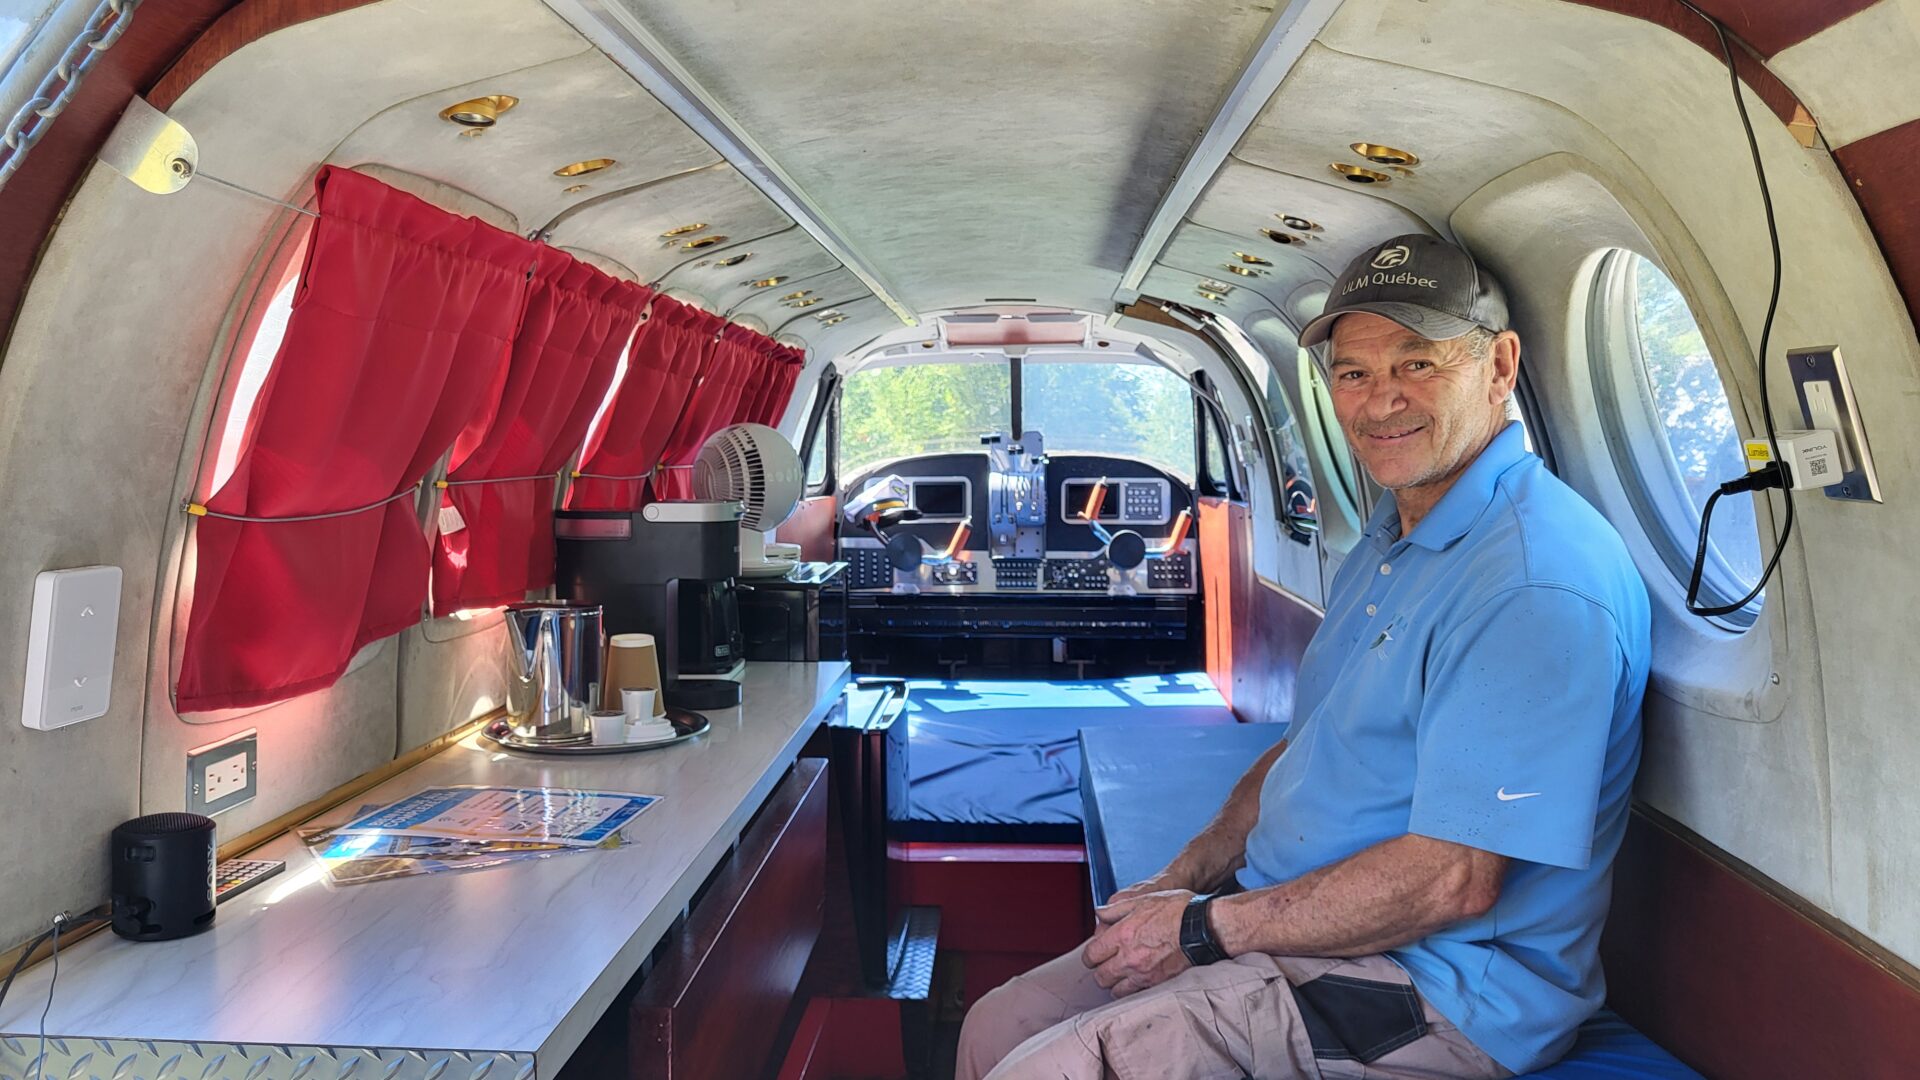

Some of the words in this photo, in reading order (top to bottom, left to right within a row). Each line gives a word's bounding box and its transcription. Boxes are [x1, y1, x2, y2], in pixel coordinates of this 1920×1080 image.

[1342, 275, 1369, 296] ULM
[1372, 271, 1438, 289] Québec
[207, 843, 215, 902] SONY
